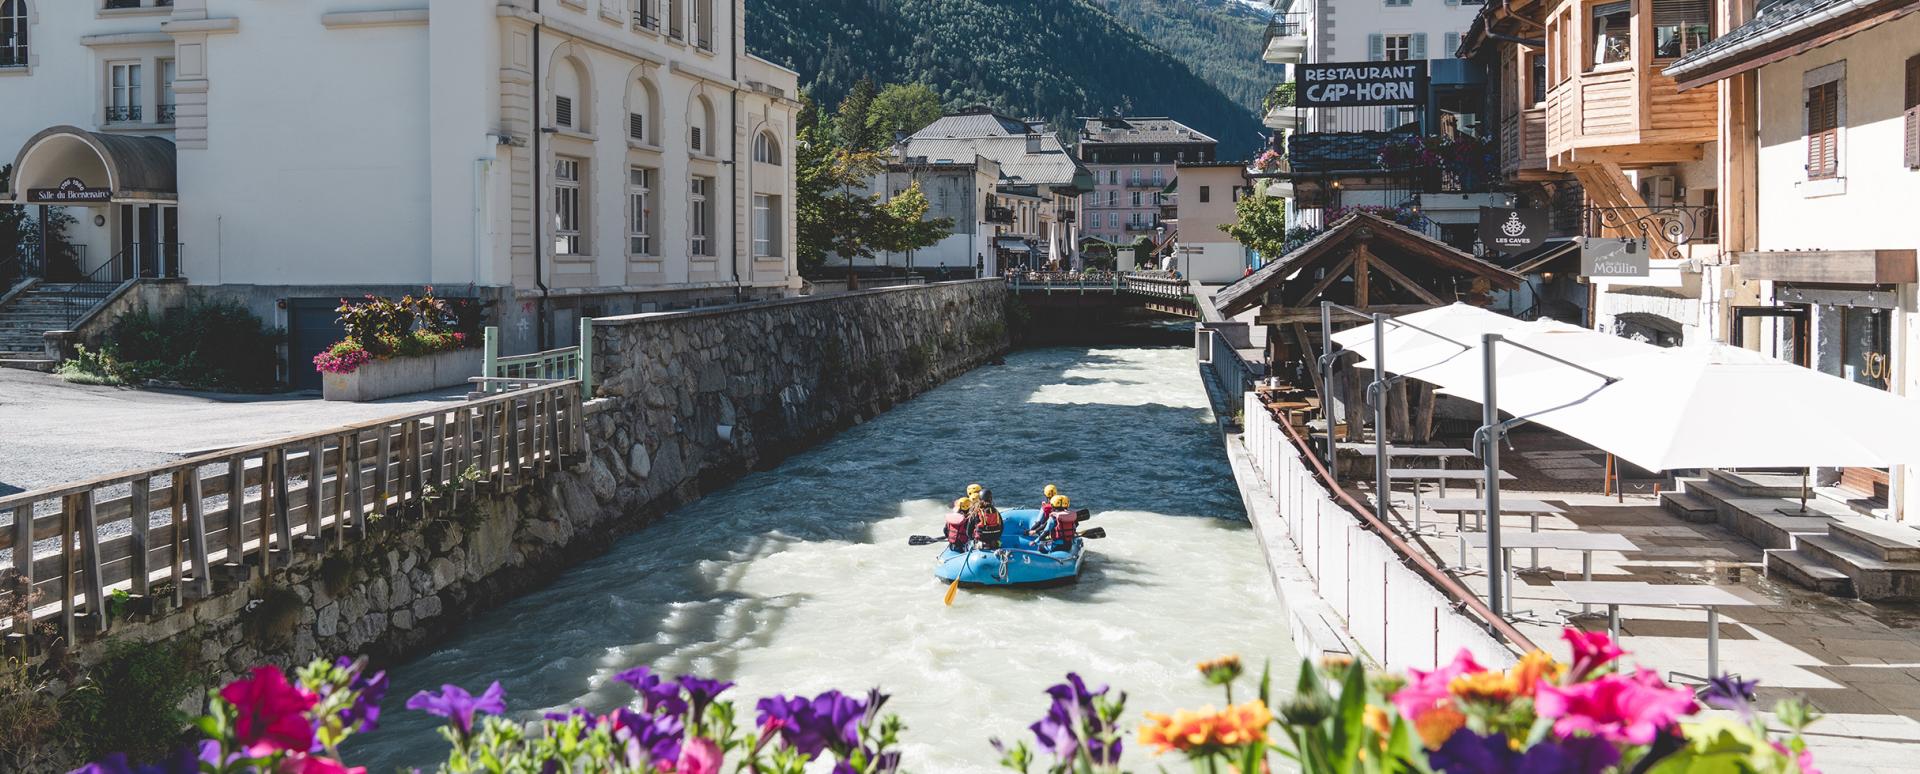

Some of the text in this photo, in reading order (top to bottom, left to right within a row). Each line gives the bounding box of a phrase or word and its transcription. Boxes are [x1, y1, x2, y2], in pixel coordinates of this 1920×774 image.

[1305, 66, 1416, 81] RESTAURANT
[1306, 81, 1414, 102] CAP-HORN
[38, 191, 54, 199] Salle
[56, 191, 65, 199] du
[1594, 262, 1637, 273] Moulin
